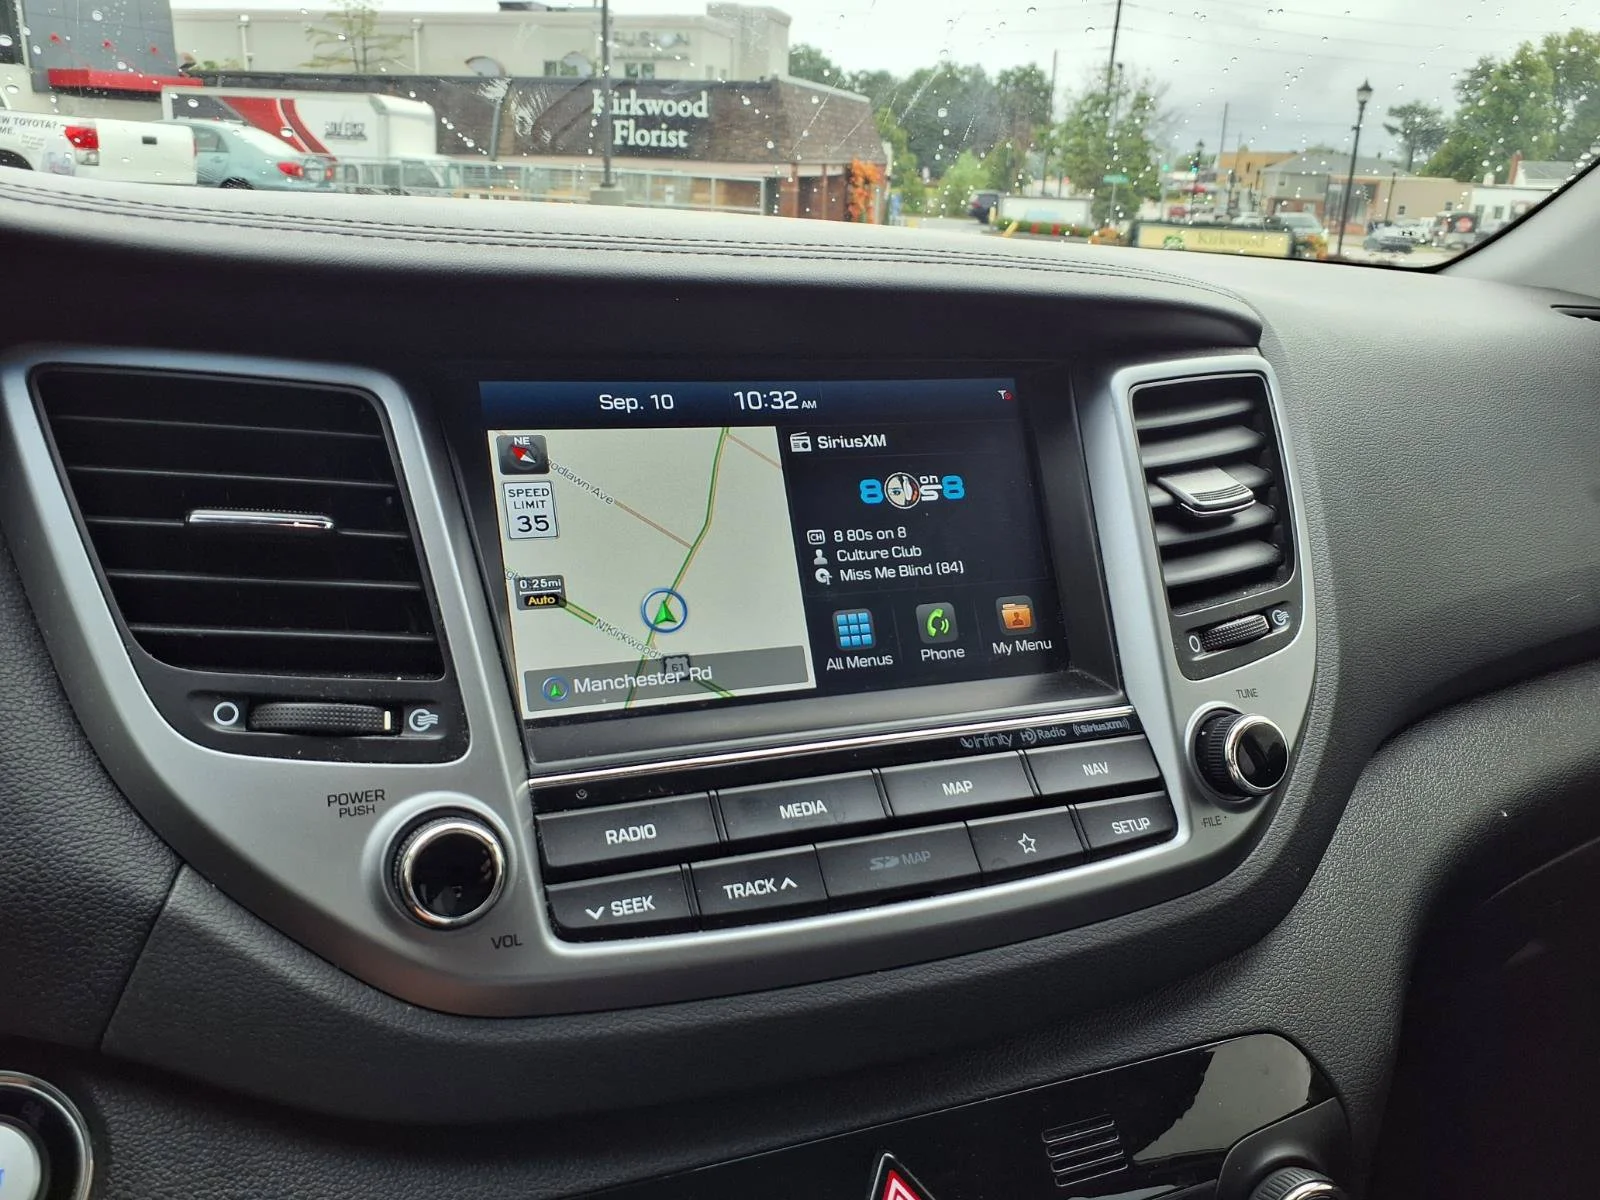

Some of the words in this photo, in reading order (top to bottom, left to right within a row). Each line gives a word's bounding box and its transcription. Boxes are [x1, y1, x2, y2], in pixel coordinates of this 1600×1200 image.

[592, 88, 709, 118] Kirkwood
[612, 119, 689, 148] Florist
[599, 394, 644, 413] Sep.
[650, 394, 674, 410] 10
[733, 391, 798, 410] 10:32
[801, 400, 817, 409] AM
[513, 436, 531, 445] NE
[817, 434, 887, 450] SiriusXM
[548, 459, 591, 491] oodlawn
[592, 487, 614, 505] Ave
[508, 488, 550, 498] SPEED
[513, 500, 546, 510] LIMIT
[516, 514, 550, 533] 35
[833, 530, 843, 542] 8
[846, 529, 873, 542] 80s
[876, 530, 894, 540] on
[897, 526, 907, 539] 8
[836, 548, 889, 562] Culture
[891, 545, 922, 558] Club
[840, 568, 872, 582] Miss
[875, 566, 896, 579] Me
[899, 563, 933, 578] Blind
[936, 560, 964, 575] (84)
[528, 595, 556, 606] Auto
[607, 623, 658, 659] Kirkwood
[992, 642, 1012, 656] My
[1015, 638, 1052, 653] Menu
[826, 656, 844, 671] All
[846, 653, 894, 670] Menus
[920, 647, 965, 662] Phone
[671, 663, 684, 672] 61
[573, 671, 685, 693] Manchester
[689, 665, 713, 681] Rd
[1235, 688, 1259, 699] TUNE
[1037, 728, 1067, 740] Radio
[1083, 761, 1109, 777] NAV
[942, 779, 974, 796] MAP
[327, 788, 386, 807] POWER
[338, 804, 376, 818] PUSH
[779, 799, 828, 819] MEDIA
[1112, 817, 1150, 835] SETUP
[1203, 815, 1222, 828] FILE
[605, 823, 657, 845] RADIO
[901, 850, 932, 867] MAP
[723, 877, 776, 900] TRACK
[611, 895, 656, 917] SEEK
[491, 934, 523, 950] VOL
